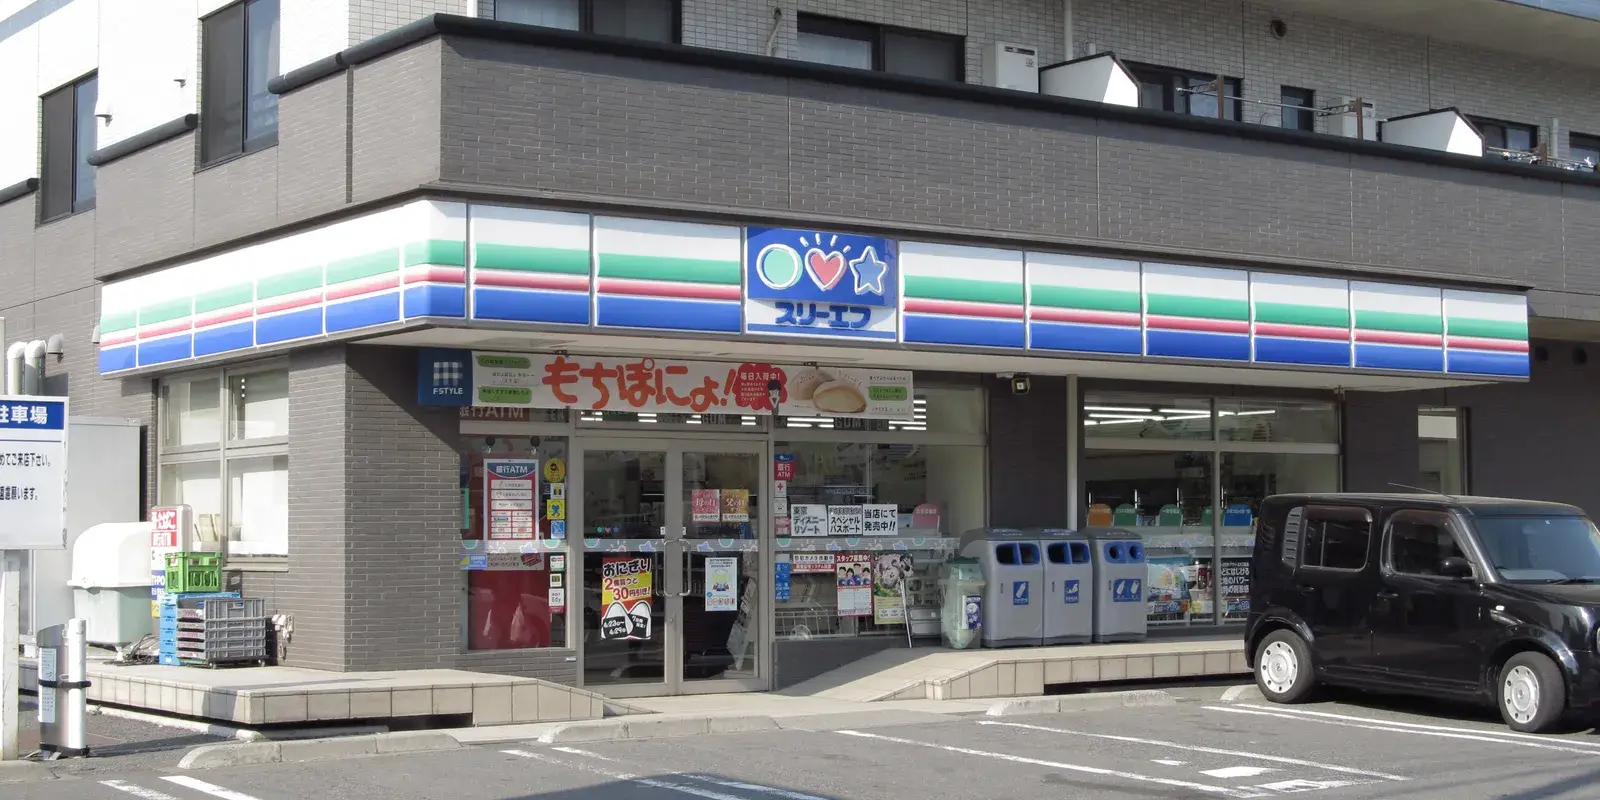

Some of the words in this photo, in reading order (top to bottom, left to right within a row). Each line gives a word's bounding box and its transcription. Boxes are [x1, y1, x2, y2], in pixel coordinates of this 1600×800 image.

[775, 302, 871, 328] スリーエフ
[496, 465, 528, 474] 銀行ATM
[793, 506, 808, 515] 東京
[864, 509, 896, 519] 当店にて
[793, 515, 825, 525] ディズニー
[830, 516, 860, 525] スペシャル
[794, 525, 820, 534] リゾート
[830, 525, 860, 533] パスポート
[864, 521, 896, 531] 発売中!!
[603, 558, 652, 577] おにぎり
[604, 577, 638, 590] 2個買うと
[613, 587, 651, 601] 30円引き!
